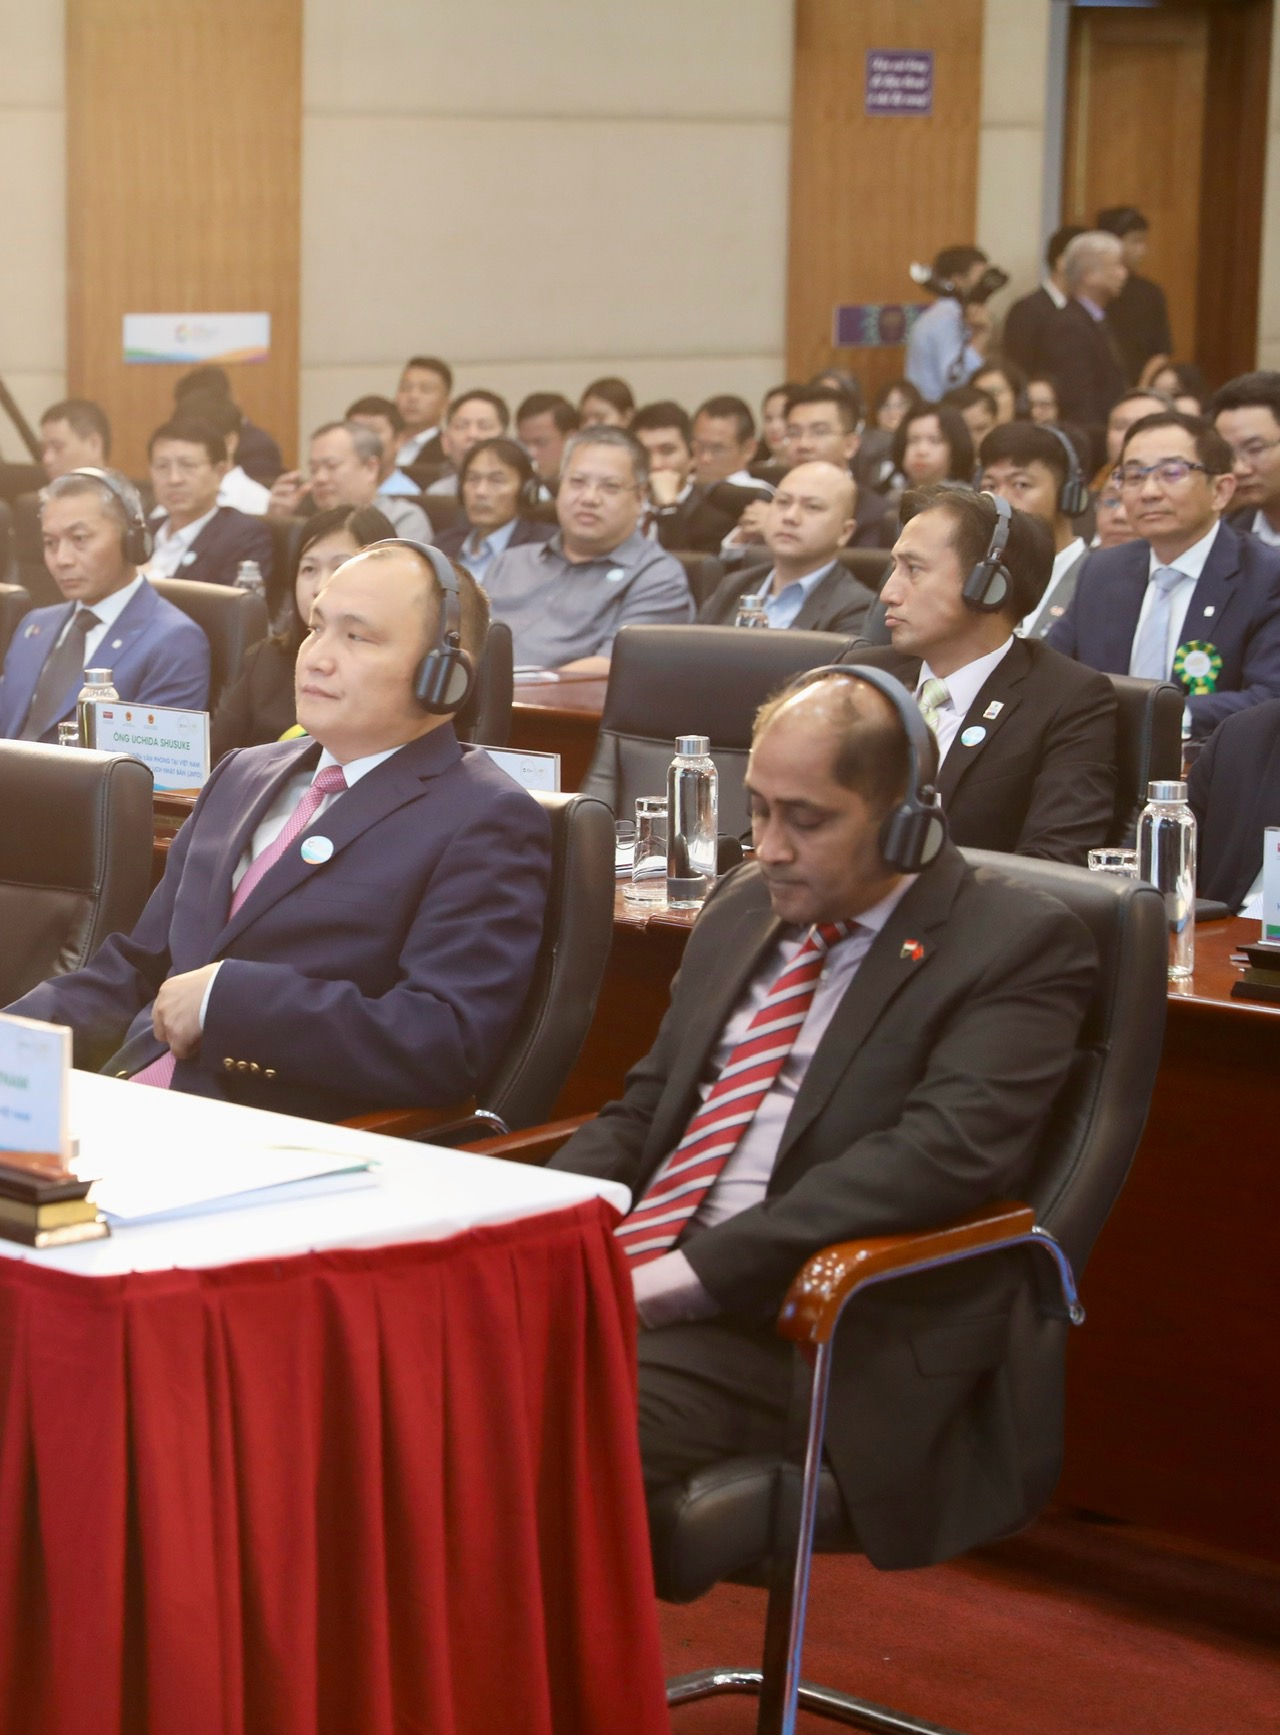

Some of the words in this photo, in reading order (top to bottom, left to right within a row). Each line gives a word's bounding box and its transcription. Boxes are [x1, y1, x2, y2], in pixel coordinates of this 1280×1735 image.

[113, 732, 130, 743] ÔNG
[132, 735, 159, 746] UCHIDA
[160, 738, 191, 751] SHUSUKE
